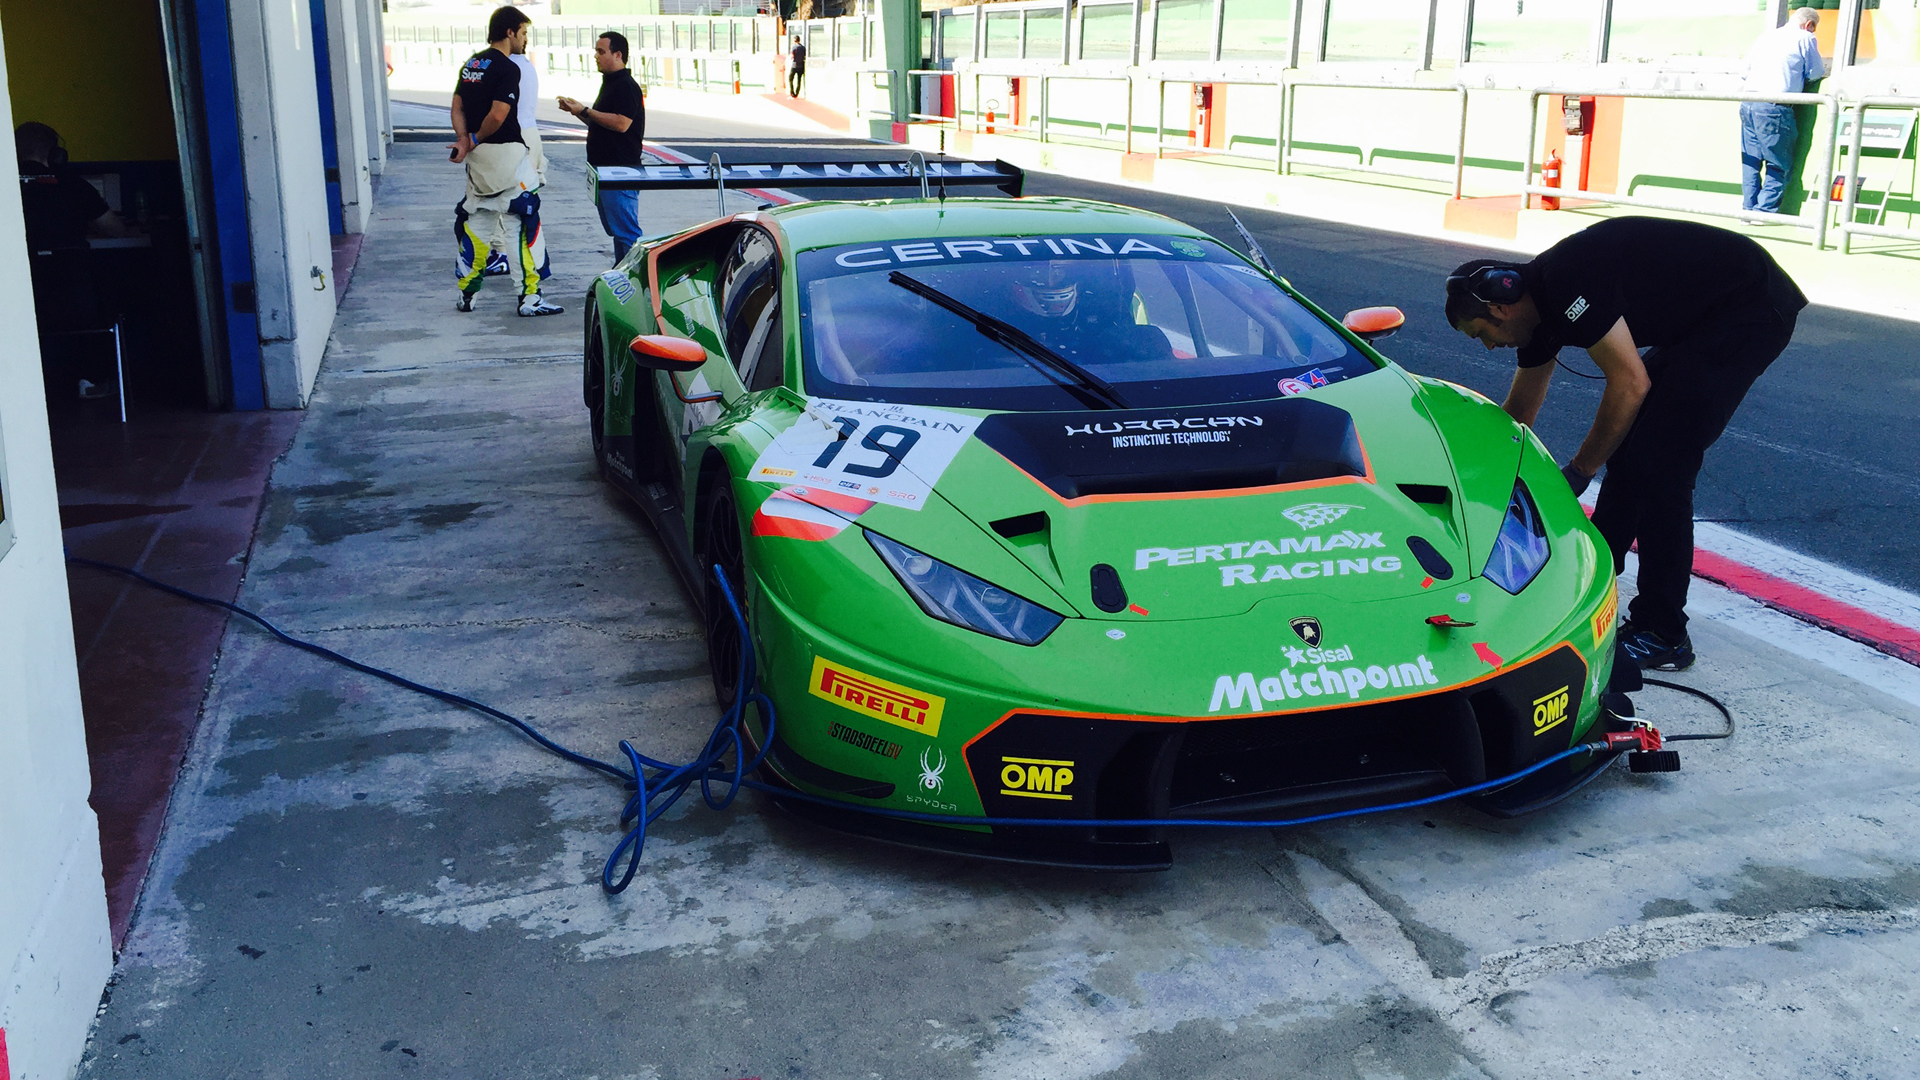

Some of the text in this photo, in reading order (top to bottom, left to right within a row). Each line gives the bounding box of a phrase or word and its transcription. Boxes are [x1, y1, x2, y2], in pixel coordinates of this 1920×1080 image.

[462, 68, 484, 82] Super
[834, 237, 1174, 268] CERTINA
[1566, 297, 1588, 321] OMP
[815, 401, 966, 435] BLANCPAIN
[811, 415, 922, 479] 19
[1112, 430, 1231, 449] INSTINCTIVE TECHNOLOGY
[888, 490, 917, 501] SRO
[1218, 556, 1402, 587] RACING
[1306, 644, 1354, 664] Sisal
[820, 667, 930, 726] PIRELLI
[1208, 654, 1439, 712] Matchpoint
[1534, 692, 1569, 728] OMP
[1001, 764, 1074, 793] OMP
[906, 794, 957, 812] SPYDER
